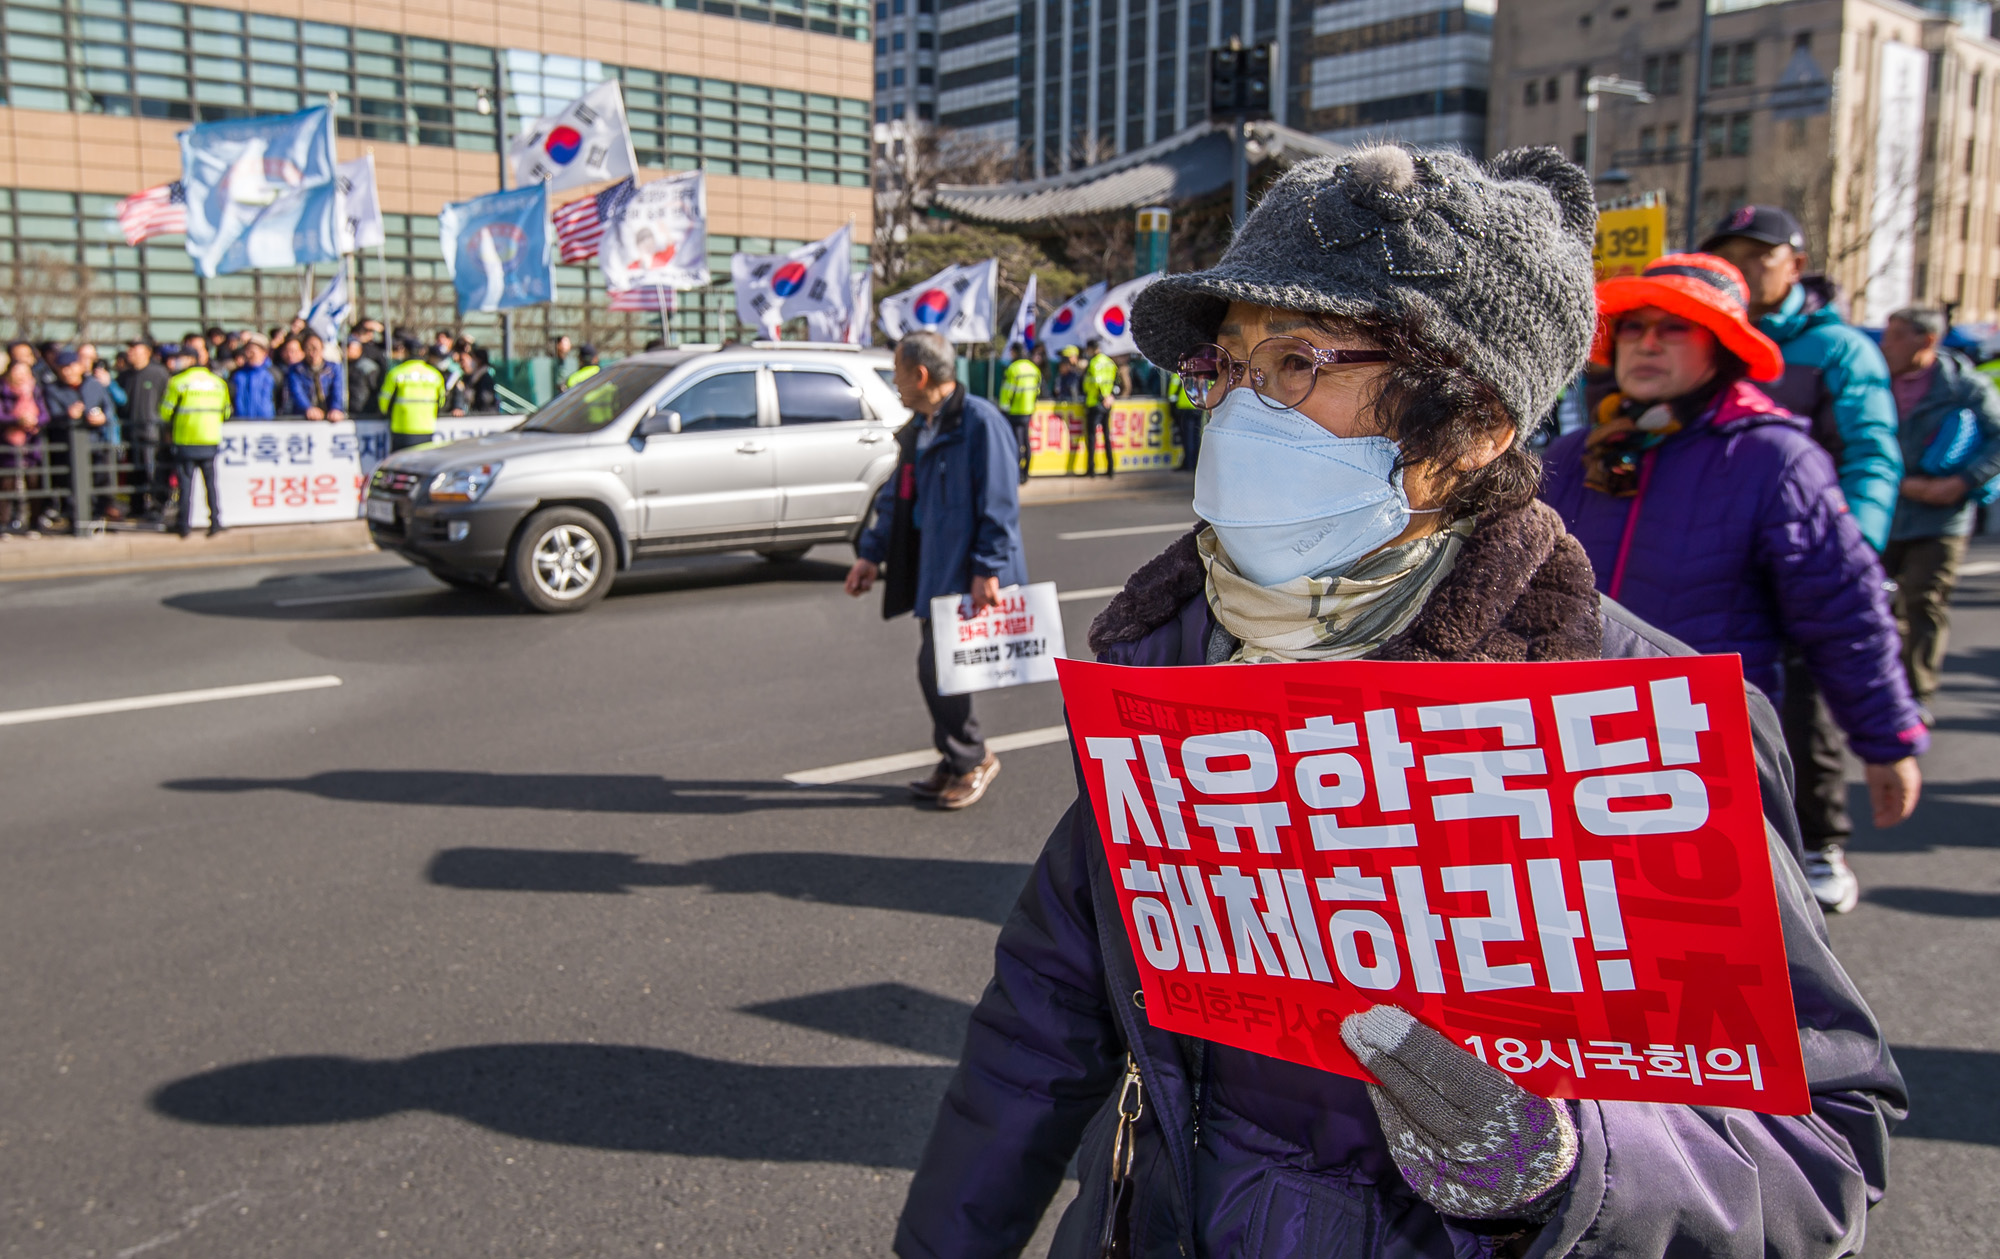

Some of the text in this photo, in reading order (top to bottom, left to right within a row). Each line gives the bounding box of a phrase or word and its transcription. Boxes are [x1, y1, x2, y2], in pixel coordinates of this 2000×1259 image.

[222, 432, 316, 466] 잔혹한
[248, 474, 339, 508] 김정은
[953, 644, 1000, 666] 특별법
[1085, 676, 1710, 853] 자유한국당
[1120, 859, 1636, 994] 해체하라!
